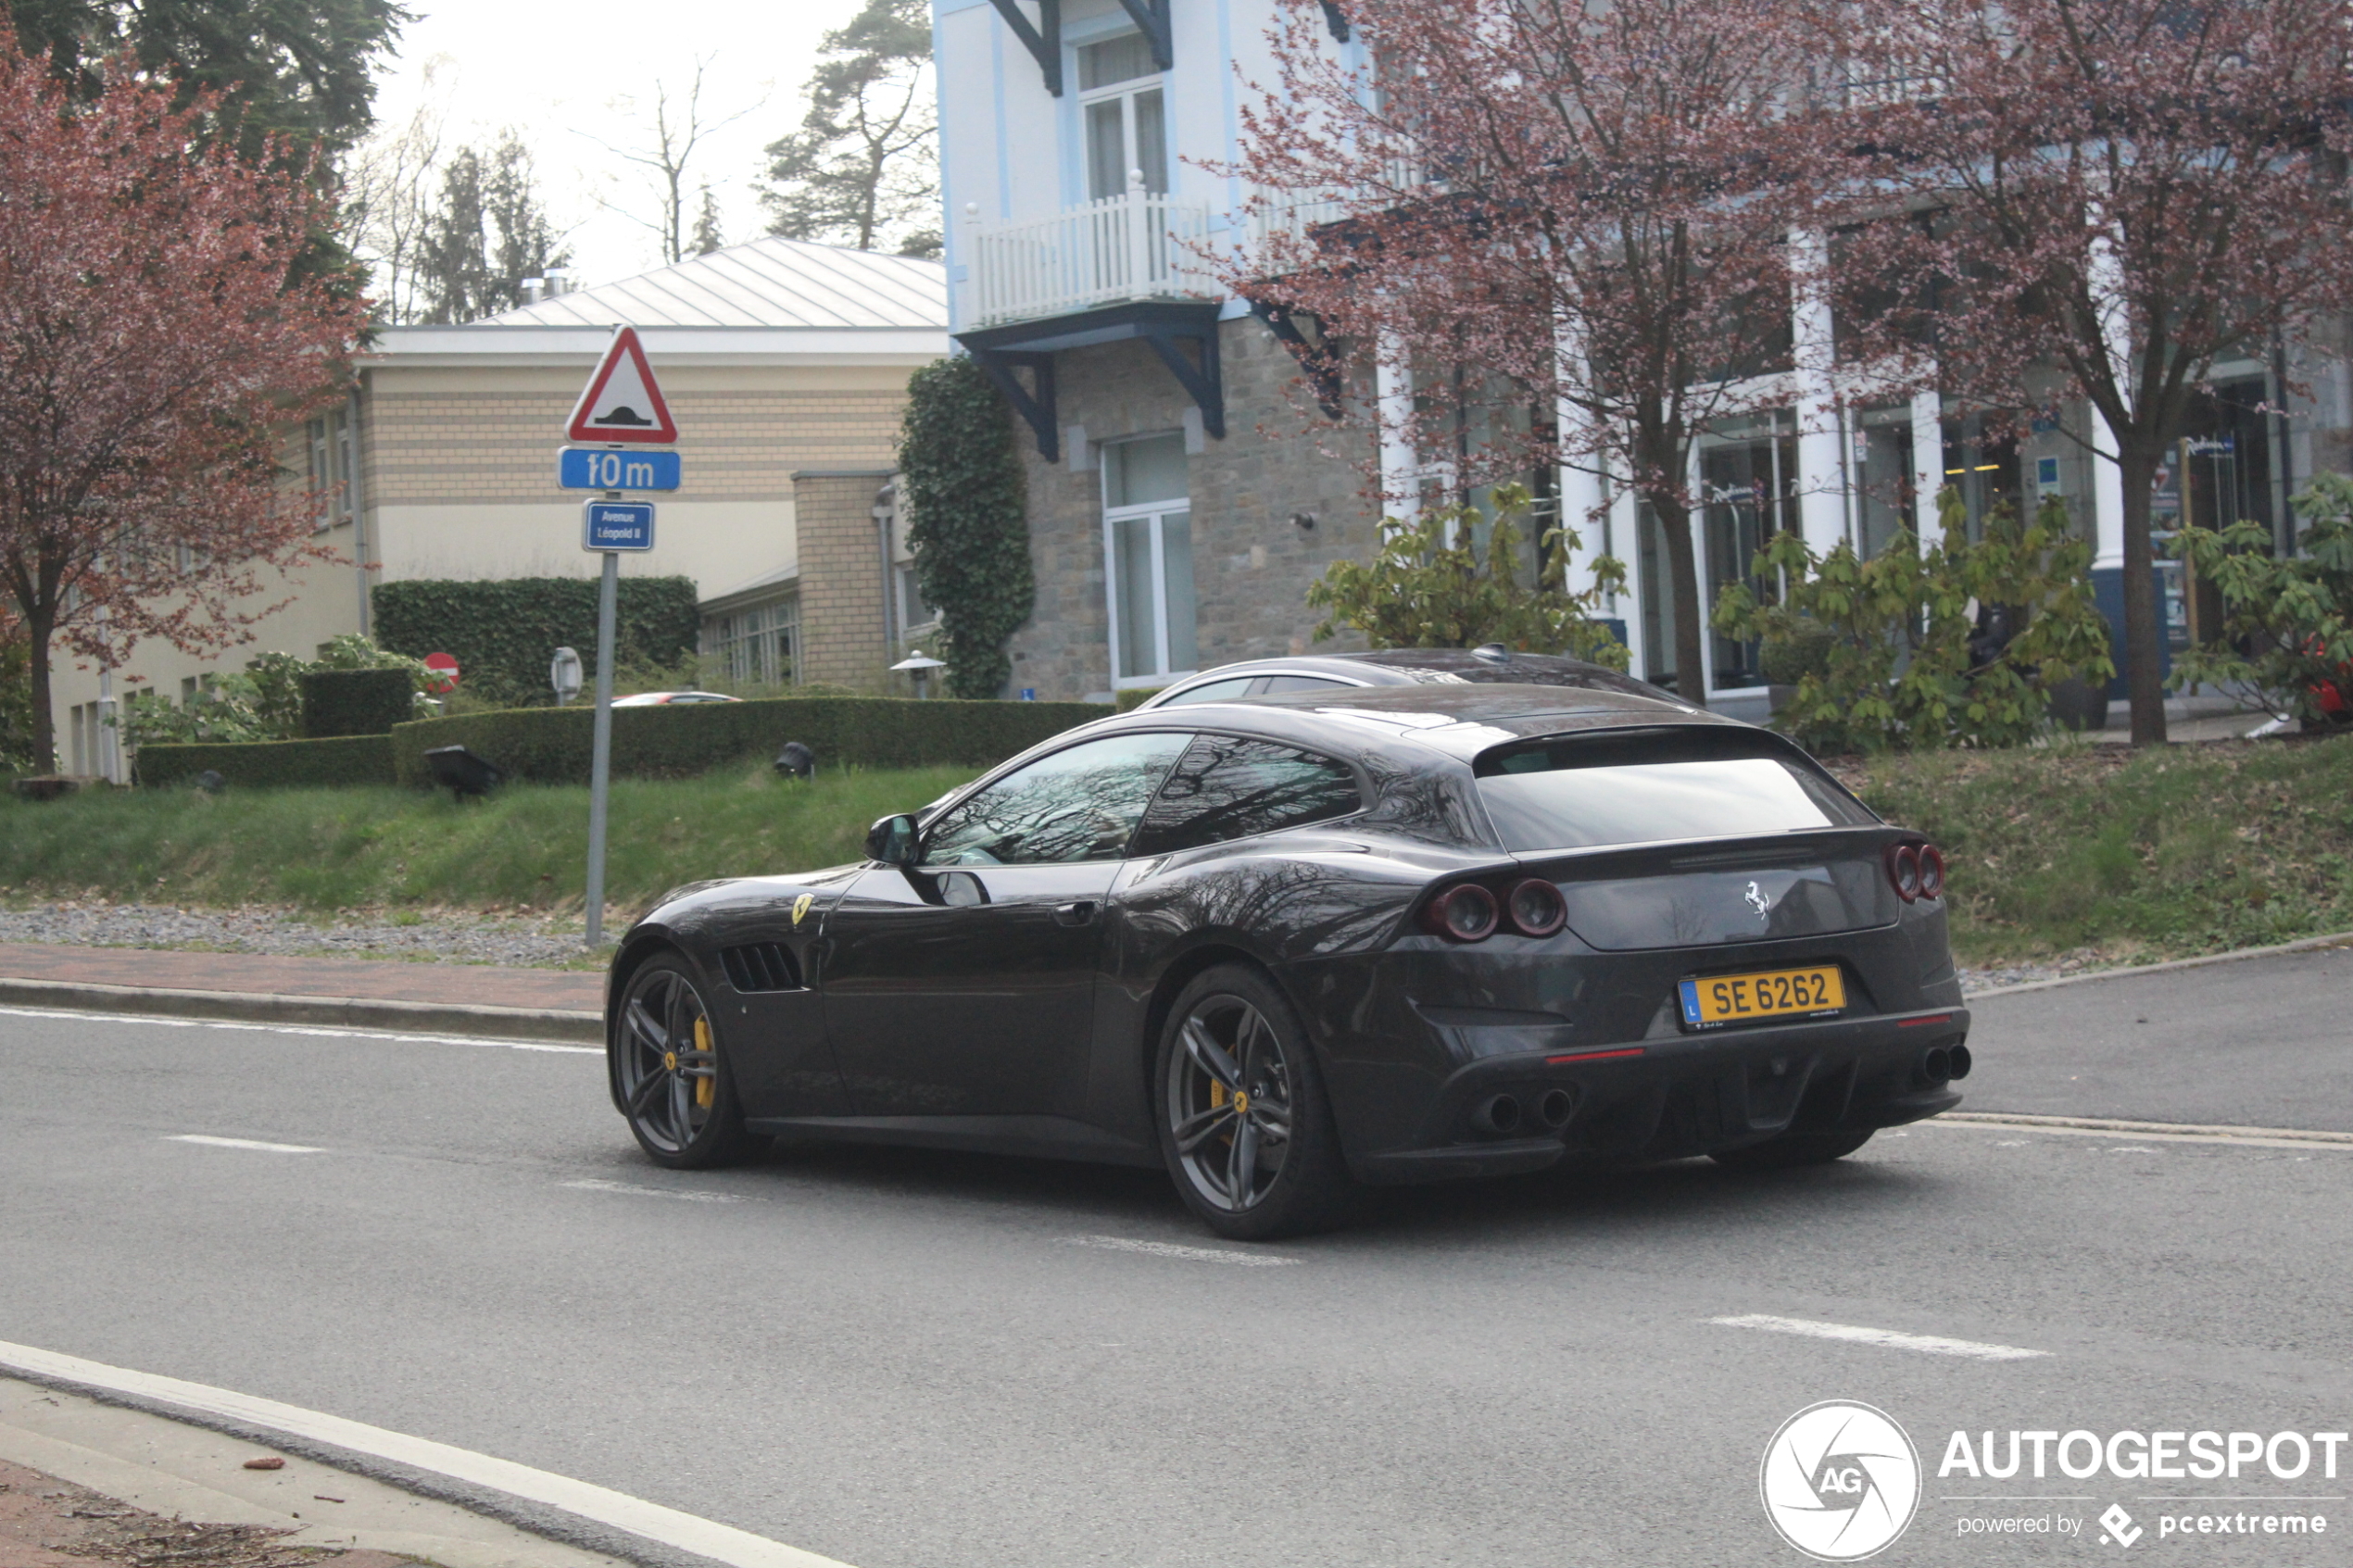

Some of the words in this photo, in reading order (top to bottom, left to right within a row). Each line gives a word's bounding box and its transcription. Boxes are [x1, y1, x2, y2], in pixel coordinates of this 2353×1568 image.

[586, 454, 621, 487] 10
[625, 461, 654, 487] m
[601, 510, 635, 523] Avenue
[597, 526, 634, 541] Léopold
[634, 528, 642, 539] II
[1713, 981, 1751, 1015] SE
[1755, 973, 1829, 1010] 6262
[1688, 1005, 1697, 1017] L
